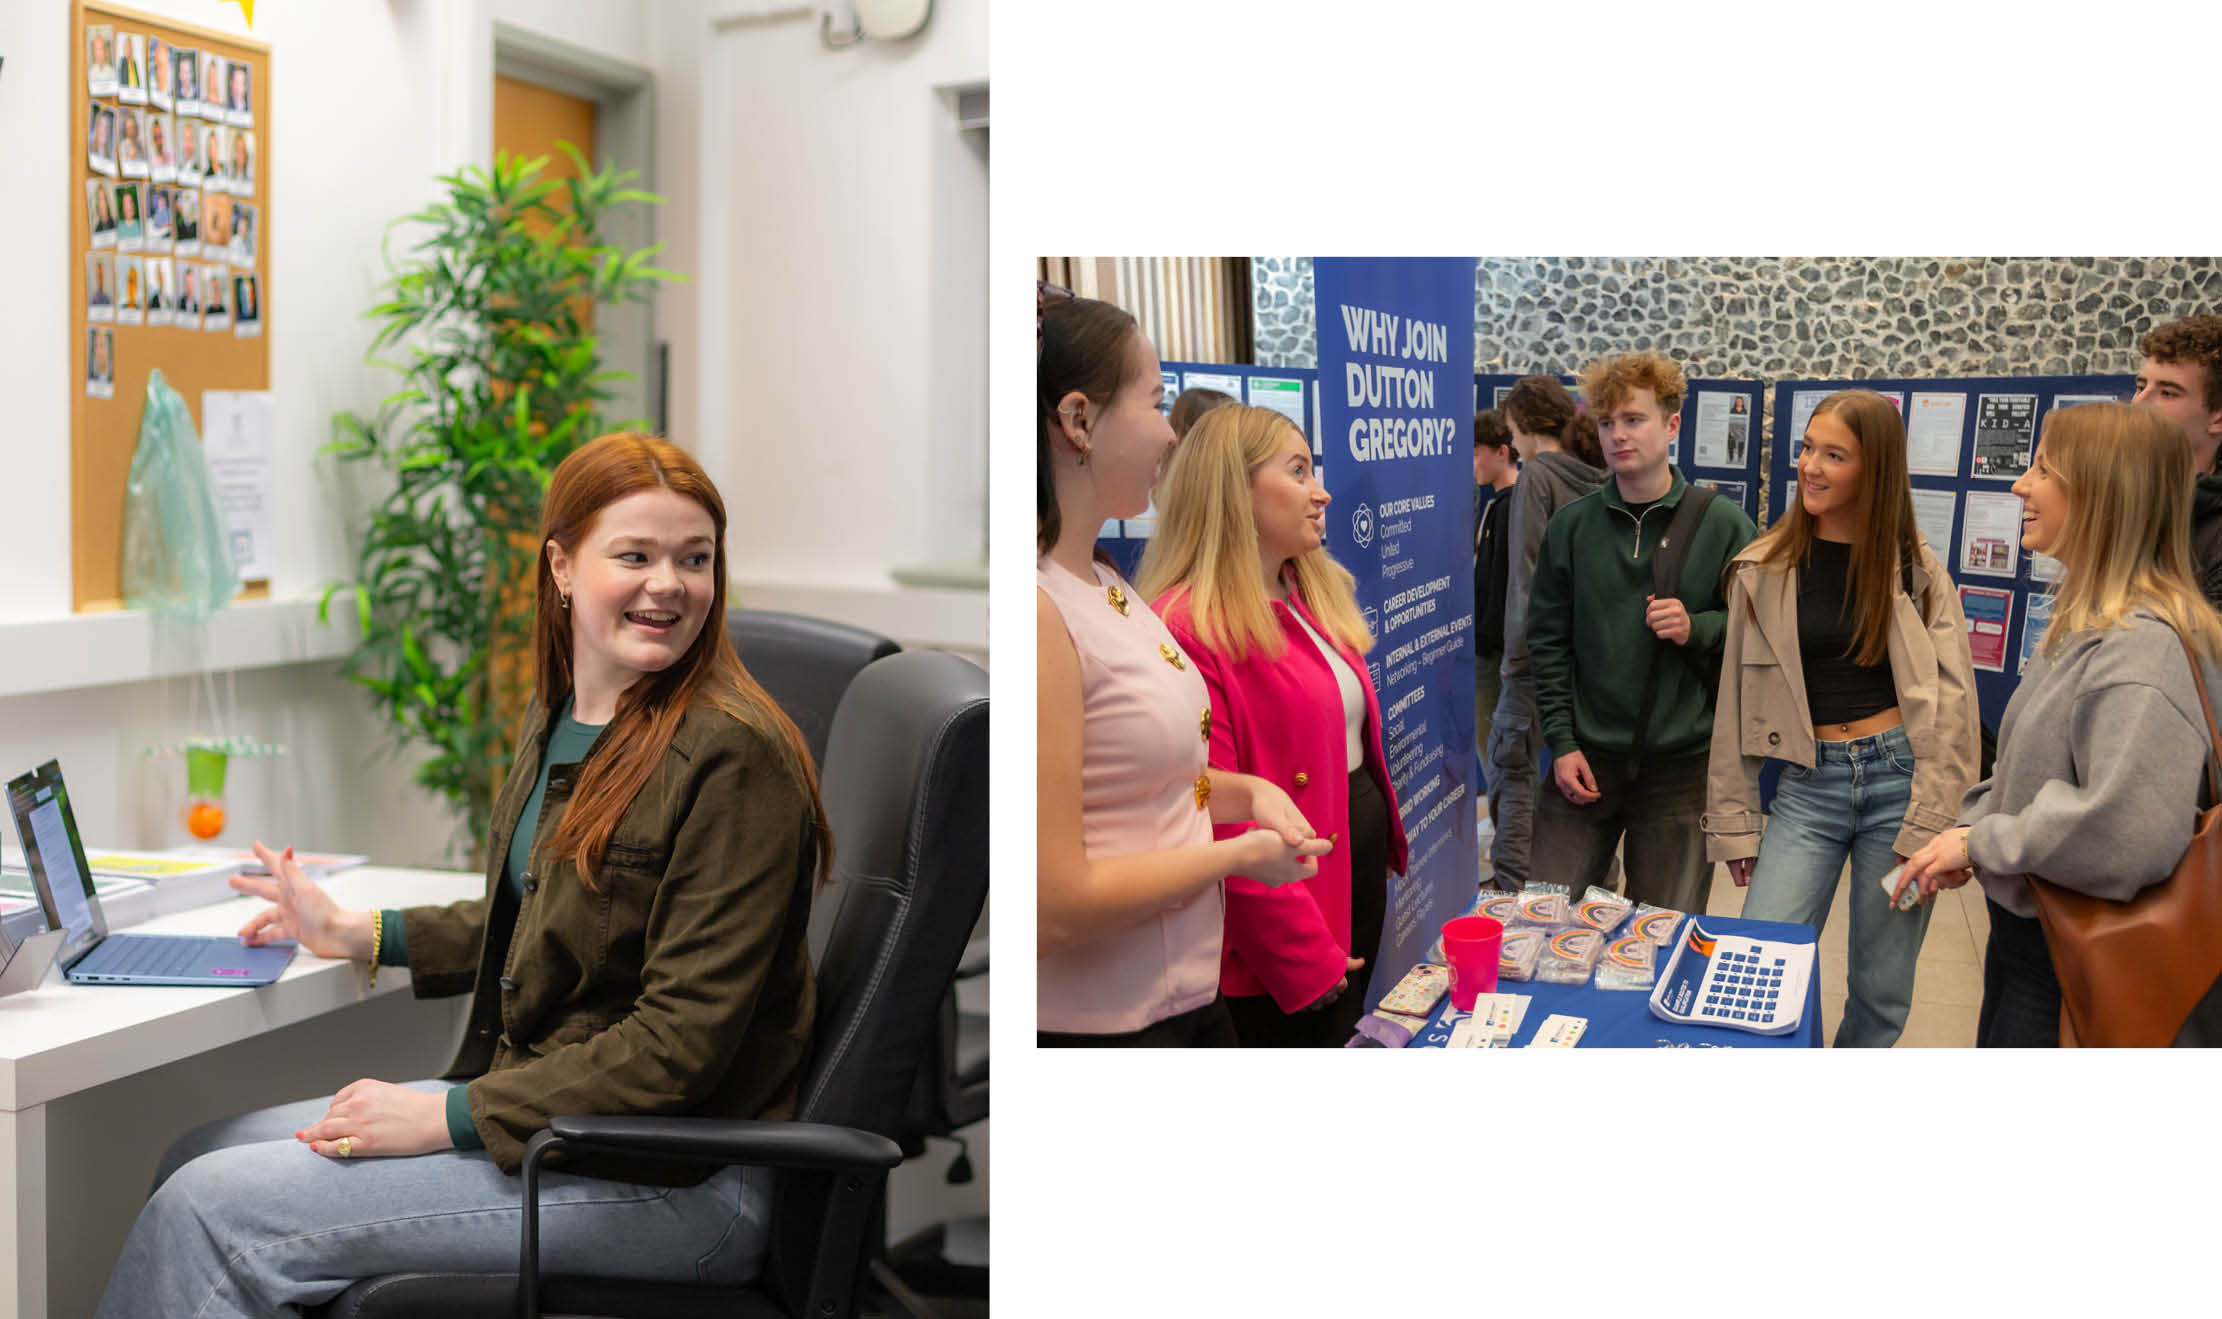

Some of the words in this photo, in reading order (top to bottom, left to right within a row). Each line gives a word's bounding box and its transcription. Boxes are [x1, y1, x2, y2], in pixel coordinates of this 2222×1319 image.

[1340, 304, 1399, 357] WHY
[1401, 318, 1448, 363] JOIN
[1346, 362, 1434, 409] DUTTON
[1349, 418, 1456, 462] GREGORY?
[1380, 501, 1393, 518] OUR
[1394, 498, 1410, 515] CORE
[1411, 494, 1435, 512] VALUES
[1380, 519, 1412, 539] Committed
[1381, 541, 1400, 560] United
[1382, 558, 1415, 580] Progressive
[1383, 591, 1406, 614] CAREER
[1407, 575, 1451, 604] DEVELOPMENT
[1384, 619, 1390, 634] &
[1390, 598, 1437, 632] OPPORTUNITIES
[1386, 643, 1414, 669] INTERNAL
[1420, 624, 1450, 650] EXTERNAL
[1450, 614, 1472, 634] EVENTS
[1386, 658, 1418, 688] Networking
[1387, 685, 1425, 721] COMMITTEES
[1388, 717, 1405, 741] Social
[1412, 774, 1441, 807] WORKING
[1440, 784, 1465, 813] CAREER
